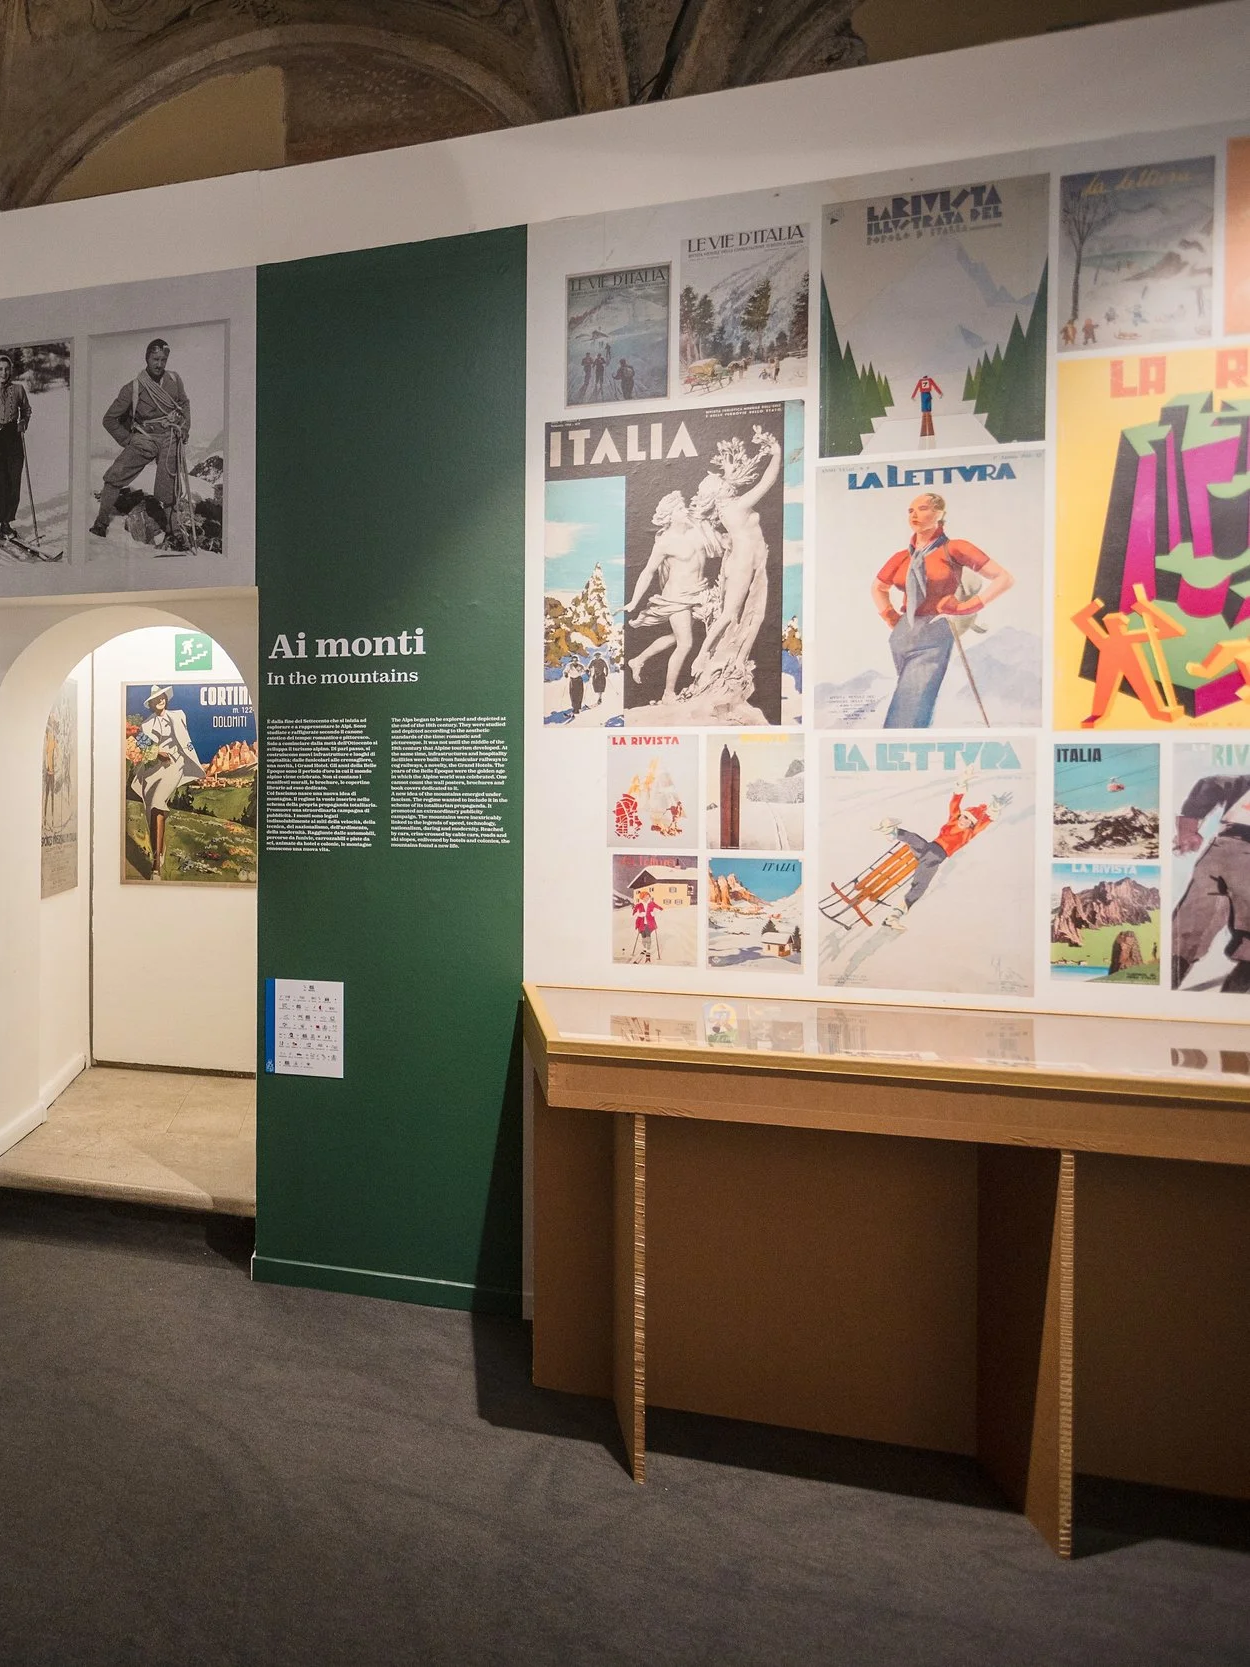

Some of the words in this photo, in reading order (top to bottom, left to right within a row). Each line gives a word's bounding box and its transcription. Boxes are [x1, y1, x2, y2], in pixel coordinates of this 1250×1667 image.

[688, 239, 706, 253] LE
[709, 234, 735, 250] VIE
[739, 225, 805, 246] D'ITALIA
[588, 276, 607, 289] VIE
[613, 269, 665, 286] D'ITALIA
[1110, 356, 1166, 398] LA
[550, 421, 698, 467] ITALIA
[848, 472, 884, 490] LA
[268, 632, 307, 659] Ai
[315, 628, 426, 657] monti
[267, 671, 285, 685] In
[289, 671, 316, 685] the
[320, 669, 418, 684] mountains
[213, 715, 247, 728] DOLOMITI
[612, 737, 627, 745] LA
[631, 737, 680, 745] RIVISTA
[834, 743, 870, 771] LA
[1057, 748, 1102, 762] ITALIA
[762, 863, 796, 872] ITALIA
